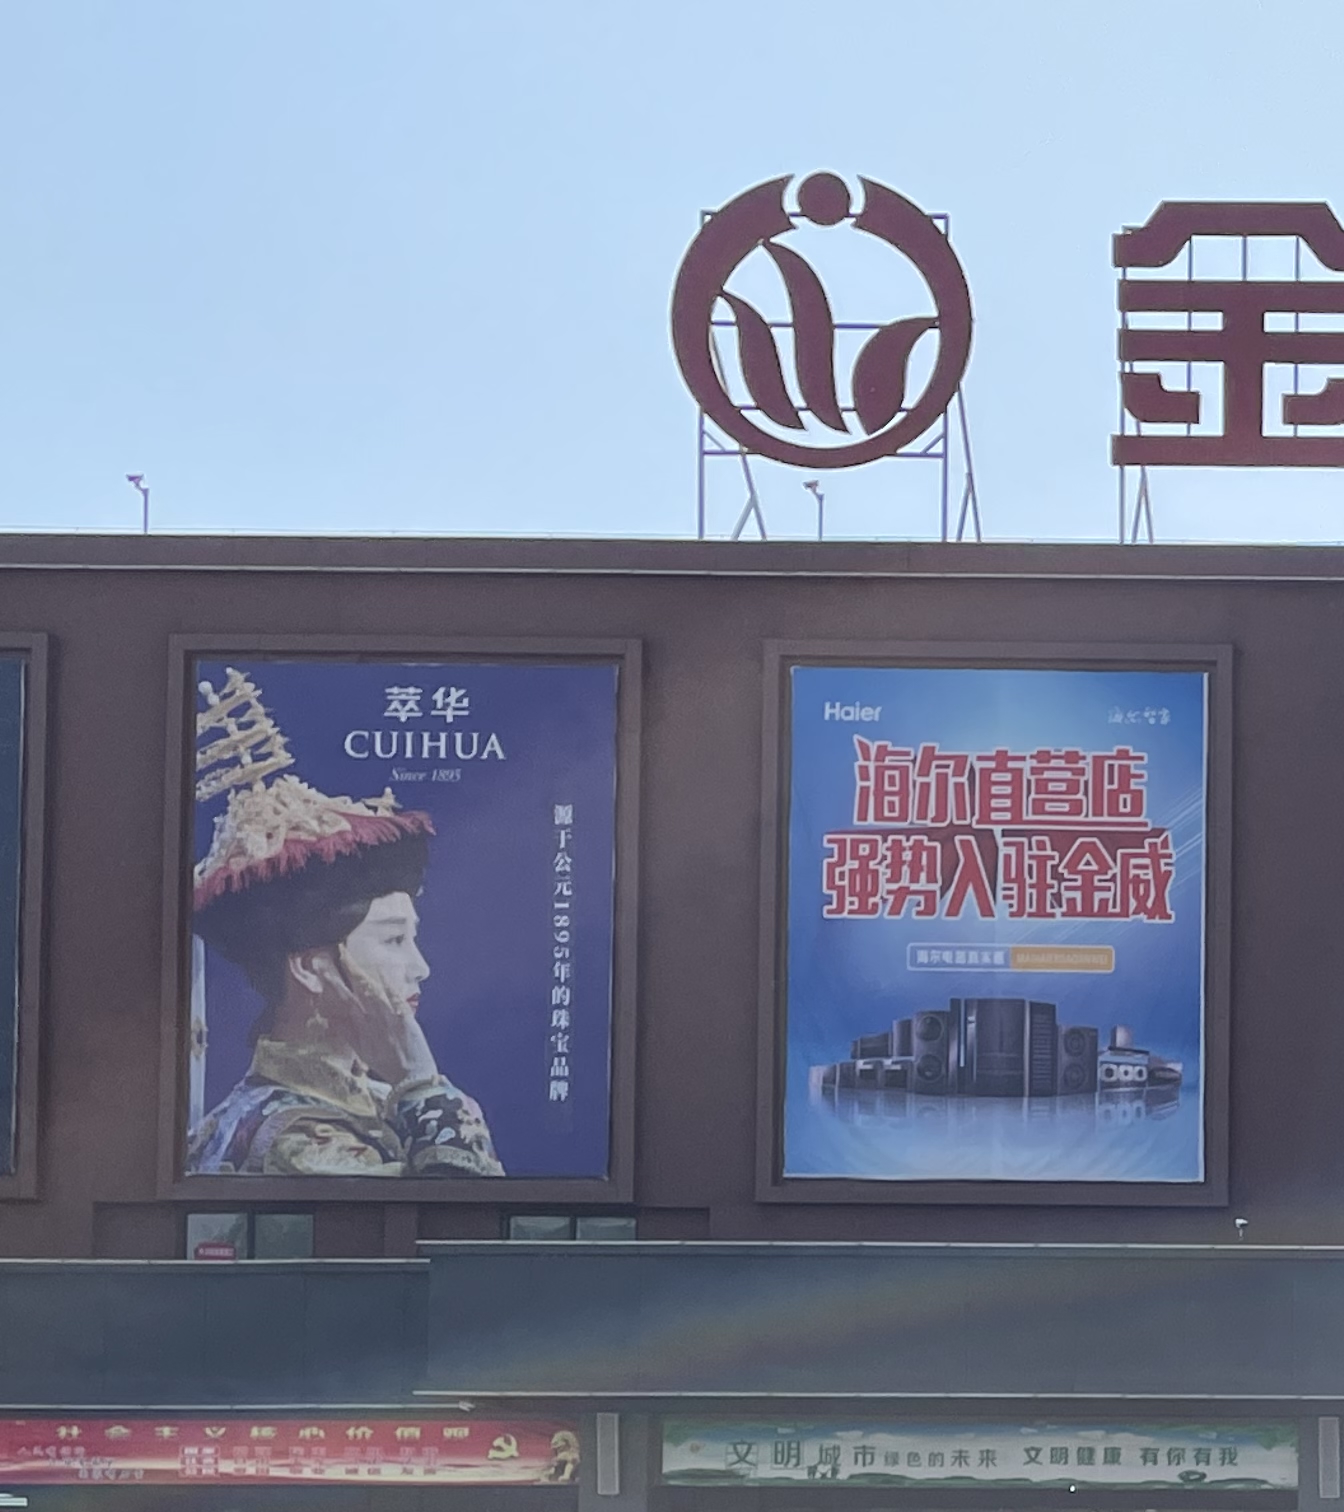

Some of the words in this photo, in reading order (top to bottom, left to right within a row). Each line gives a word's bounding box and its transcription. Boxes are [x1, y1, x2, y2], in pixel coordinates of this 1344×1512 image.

[384, 686, 470, 723] 萃华
[823, 701, 882, 724] Haier
[344, 730, 507, 761] CUIHUA
[390, 767, 426, 782] Since
[853, 734, 1150, 829] 海尔直营店
[823, 832, 1175, 924] 强势入驻金威
[548, 803, 574, 1102] 源于公元1895年的珠宝品牌
[1022, 1445, 1124, 1468] 文明健康
[1139, 1445, 1240, 1468] 有你有我
